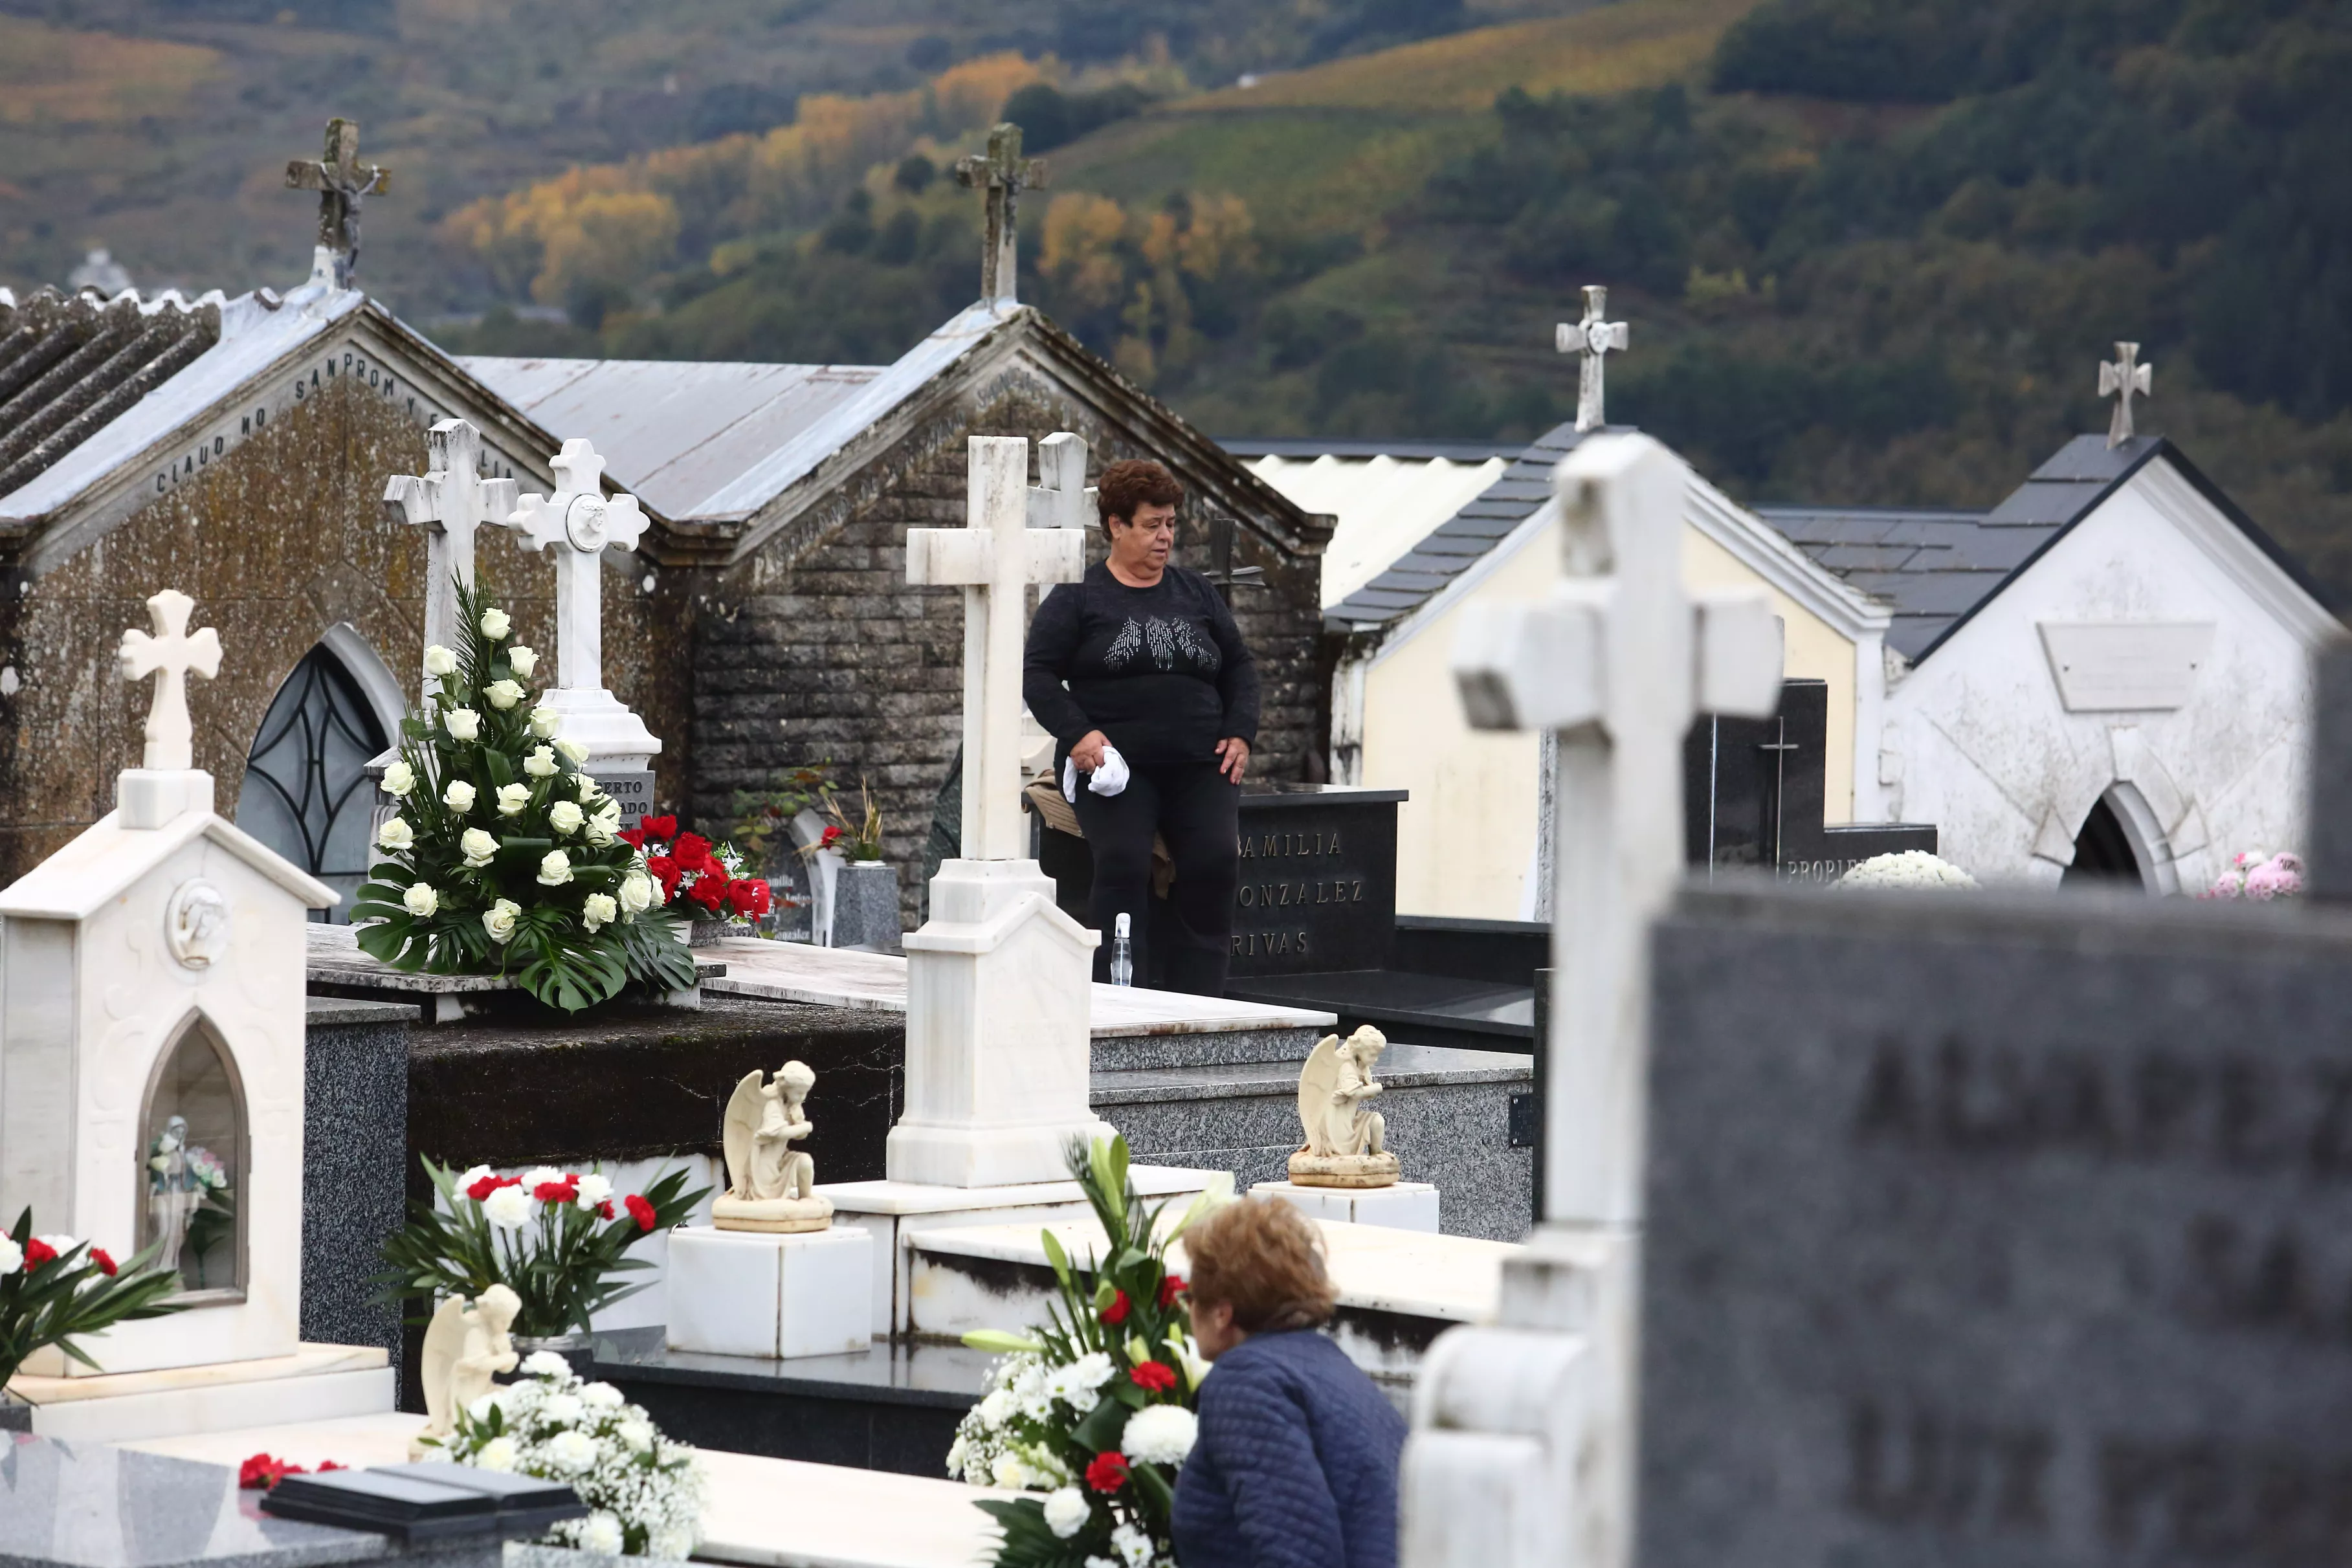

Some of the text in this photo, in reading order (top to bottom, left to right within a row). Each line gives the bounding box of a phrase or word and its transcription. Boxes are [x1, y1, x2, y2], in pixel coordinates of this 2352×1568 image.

[407, 397, 415, 415] Y
[619, 801, 648, 814] ADO
[1237, 833, 1342, 857] AMILIA
[1787, 859, 1868, 884] PROPI
[1239, 880, 1363, 907] ONZALEZ
[1230, 932, 1307, 956] RIVAS
